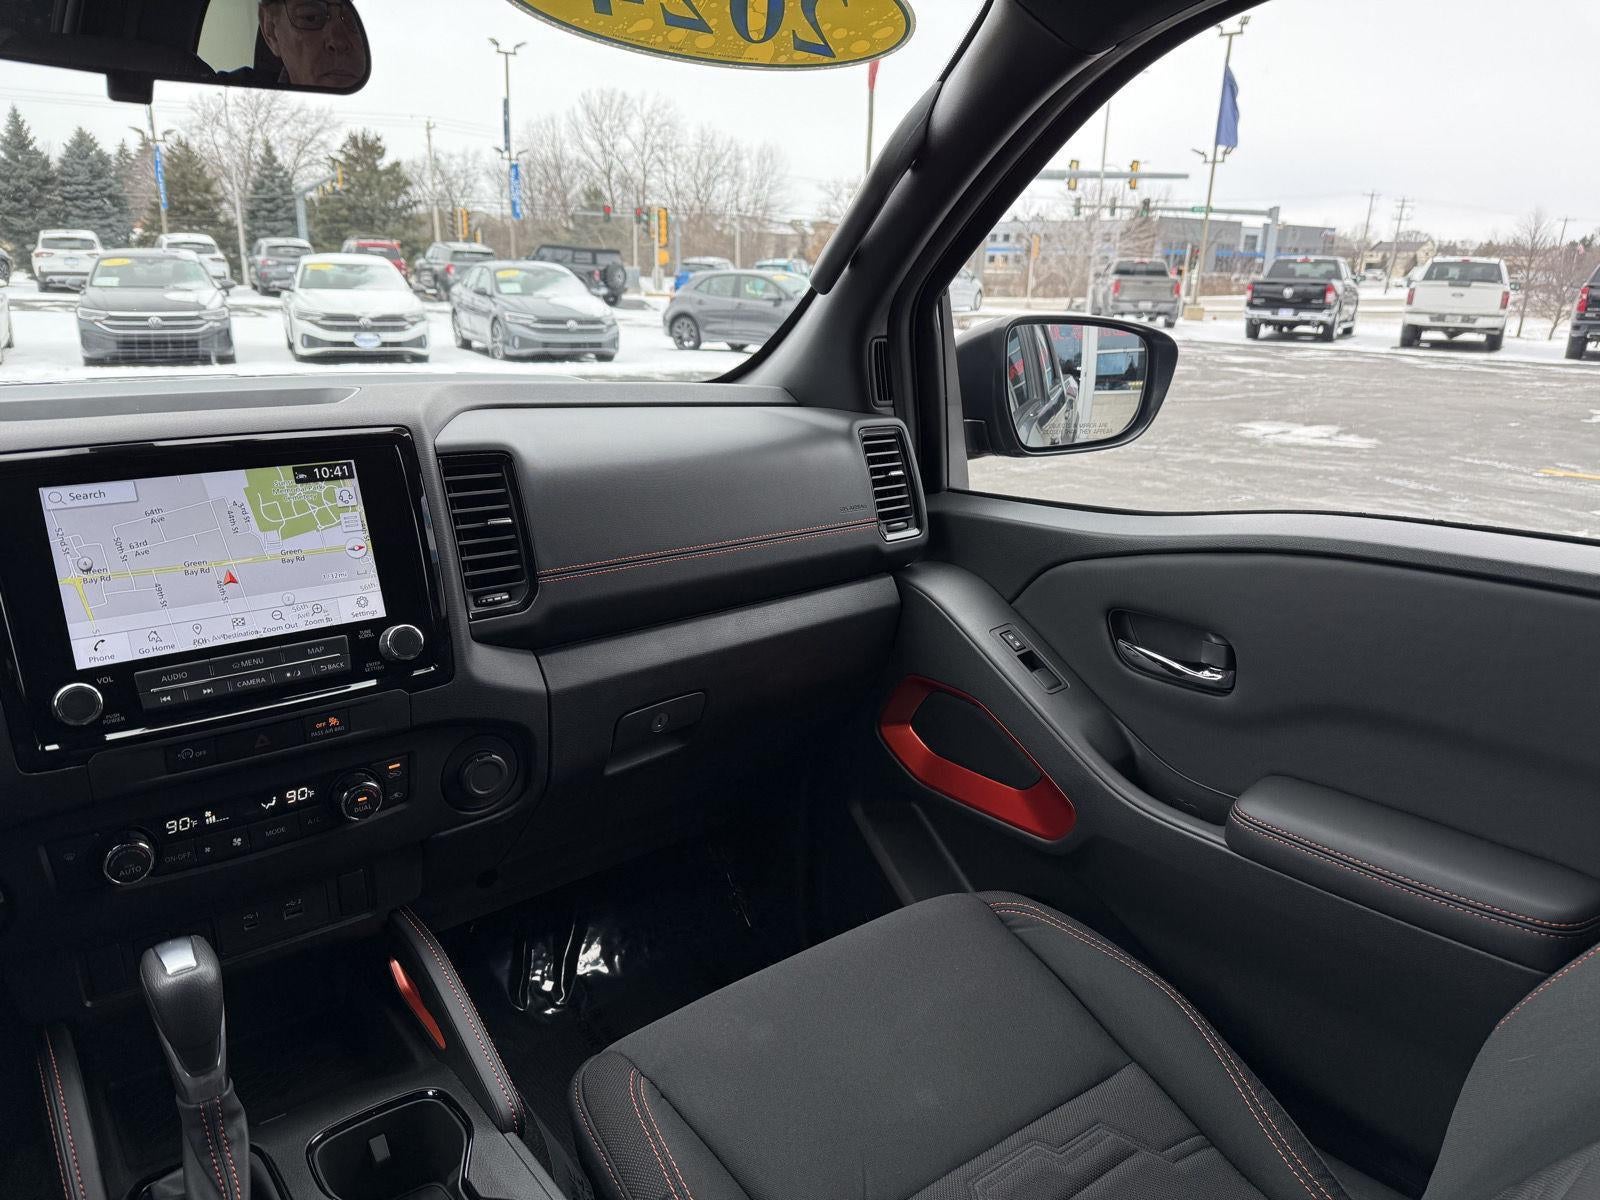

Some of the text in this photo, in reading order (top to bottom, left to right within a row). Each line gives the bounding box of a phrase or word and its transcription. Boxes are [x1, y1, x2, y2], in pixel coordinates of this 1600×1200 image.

[313, 464, 350, 480] 10:41
[68, 489, 106, 501] Search
[144, 507, 163, 517] 64th
[150, 515, 165, 525] Ave
[129, 539, 148, 550] 63rd
[134, 548, 150, 557] Ave
[280, 548, 303, 556] Green
[184, 560, 208, 568] Green
[281, 555, 306, 564] Bay Rd
[184, 567, 210, 577] Bay Rd
[82, 577, 98, 585] Bay
[351, 609, 378, 618] Settings
[263, 622, 299, 633] Zoom Out
[304, 618, 324, 627] Zoom
[138, 643, 175, 655] Go Home
[307, 646, 325, 655] MAP
[88, 653, 115, 664] Phone
[241, 657, 264, 669] MENU
[327, 661, 345, 671] BACK
[97, 675, 114, 685] VOL
[160, 671, 188, 683] AUDIO
[236, 676, 266, 688] CAMERA
[354, 804, 372, 813] DUAL
[265, 826, 287, 837] MODE
[118, 865, 142, 877] AUTO
